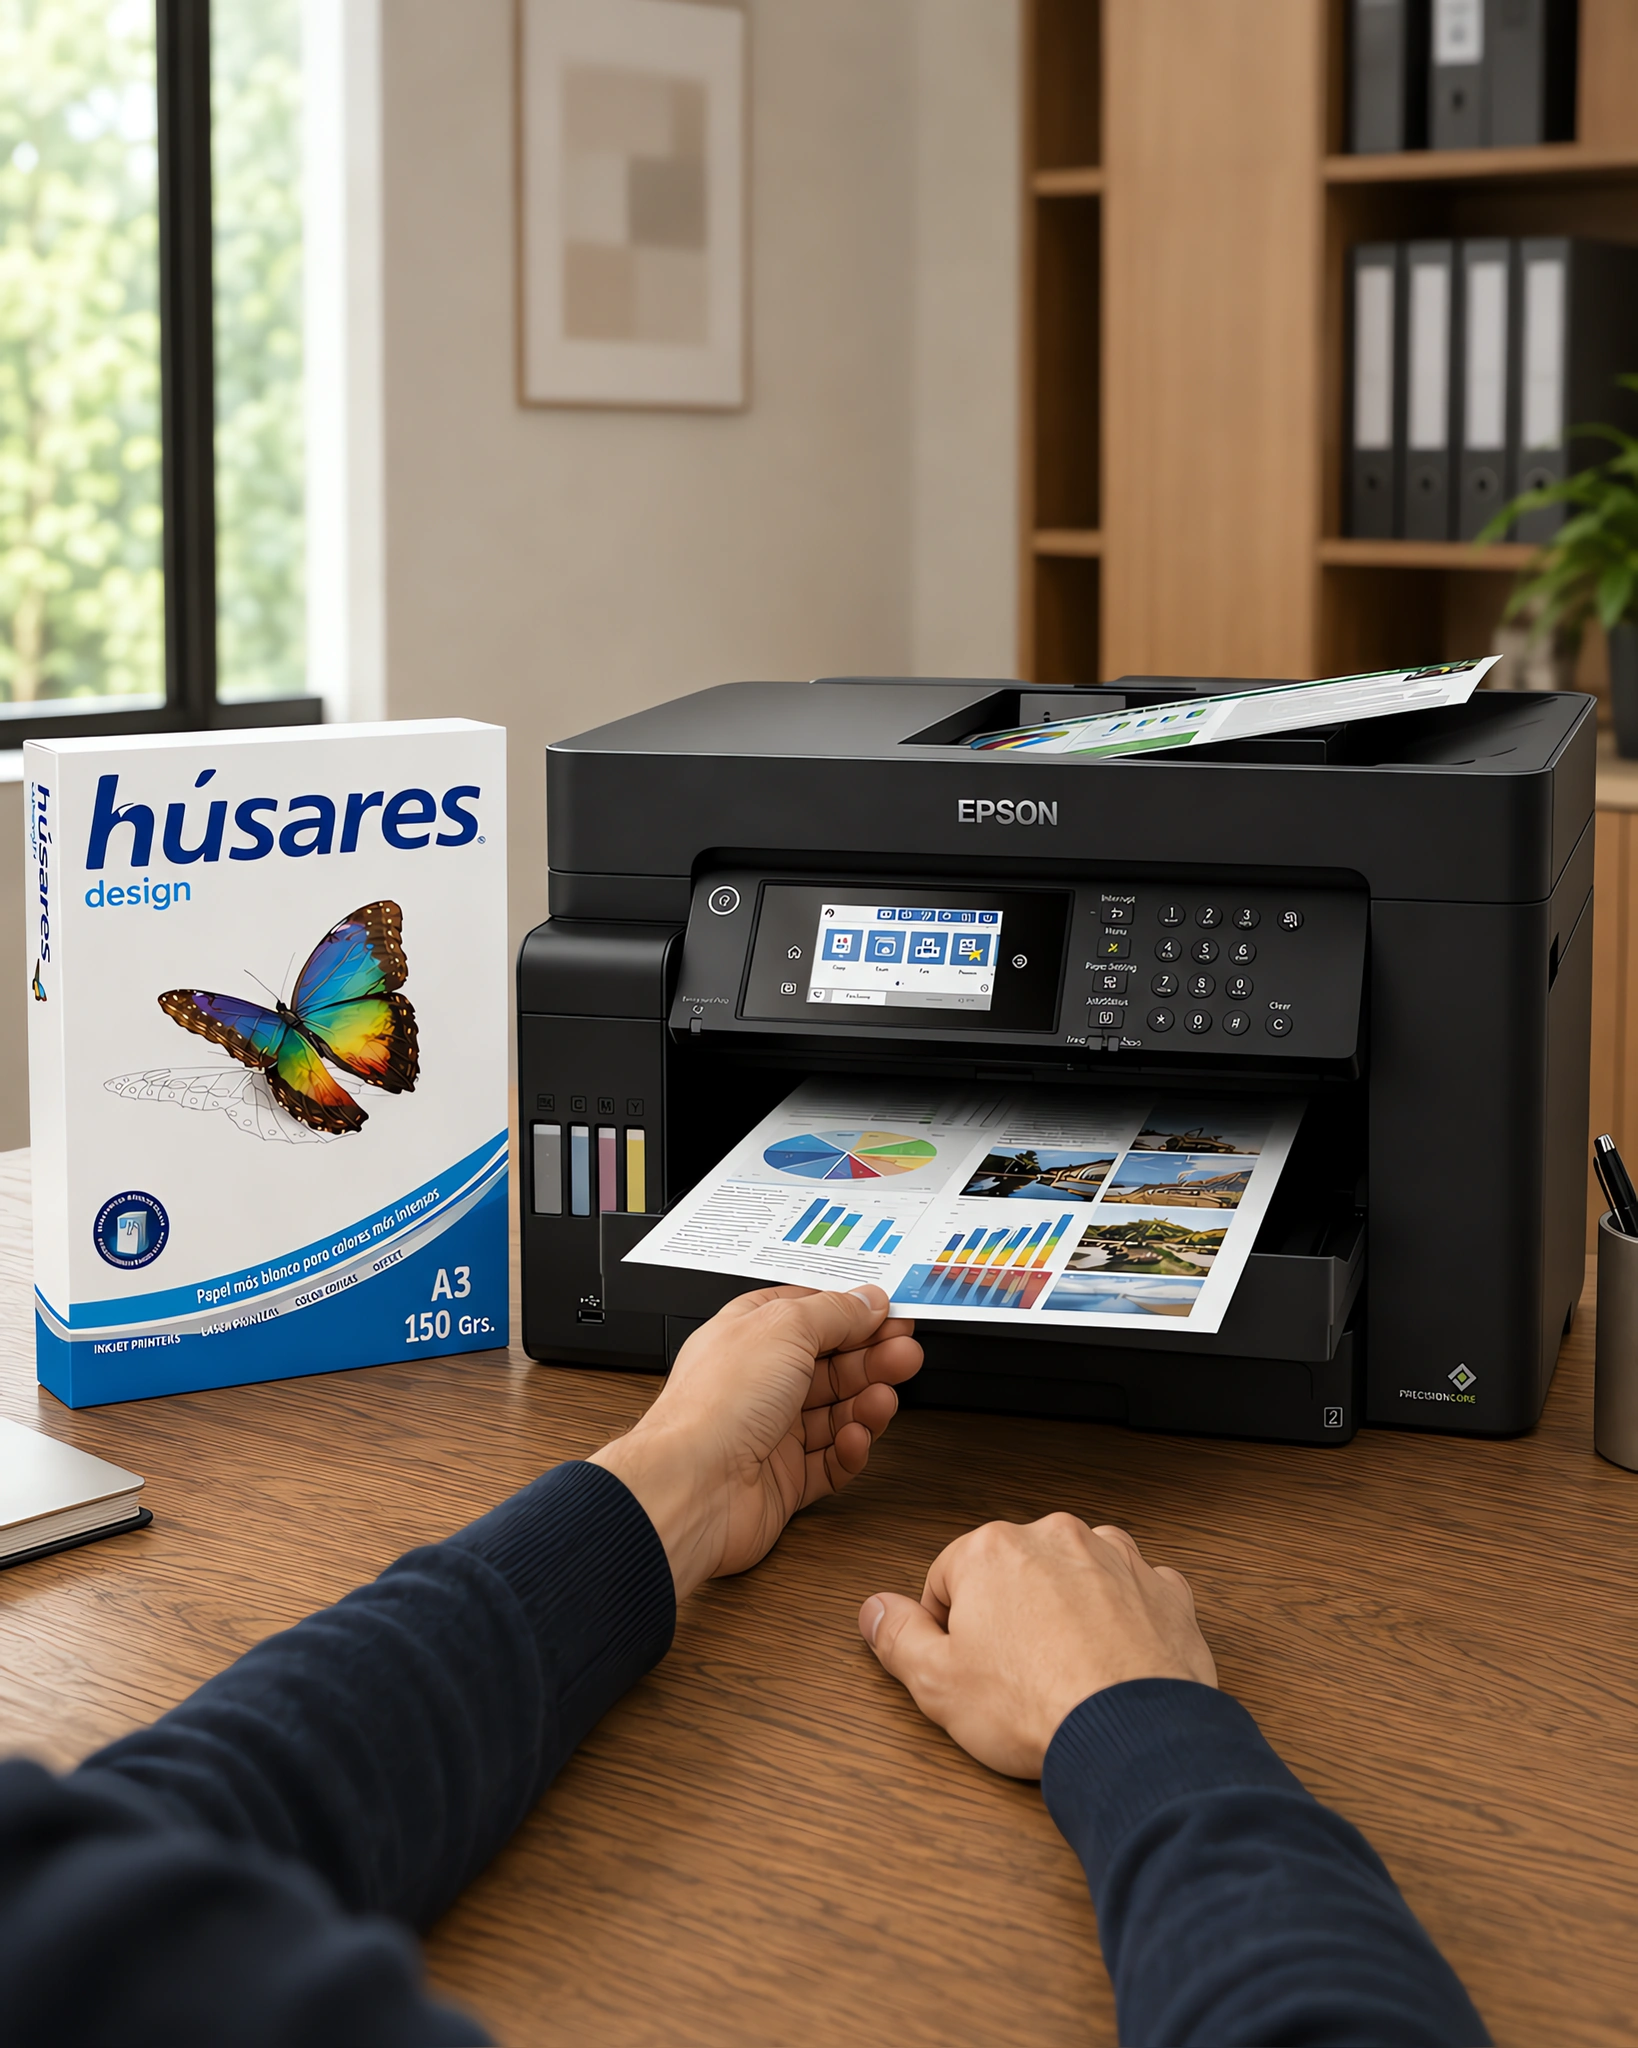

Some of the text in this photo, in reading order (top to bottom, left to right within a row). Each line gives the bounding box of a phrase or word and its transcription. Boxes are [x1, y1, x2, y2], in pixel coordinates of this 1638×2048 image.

[86, 769, 481, 870] húsares
[958, 799, 1058, 826] EPSON
[37, 784, 52, 963] húsares
[85, 877, 191, 911] design
[1206, 908, 1214, 919] 2
[1243, 909, 1251, 920] 3
[1239, 944, 1247, 955] 6
[1273, 1019, 1284, 1030] C
[631, 1102, 641, 1113] Y
[431, 1265, 472, 1302] A3
[405, 1309, 496, 1344] 150 Grs.
[1328, 1409, 1338, 1425] 2
